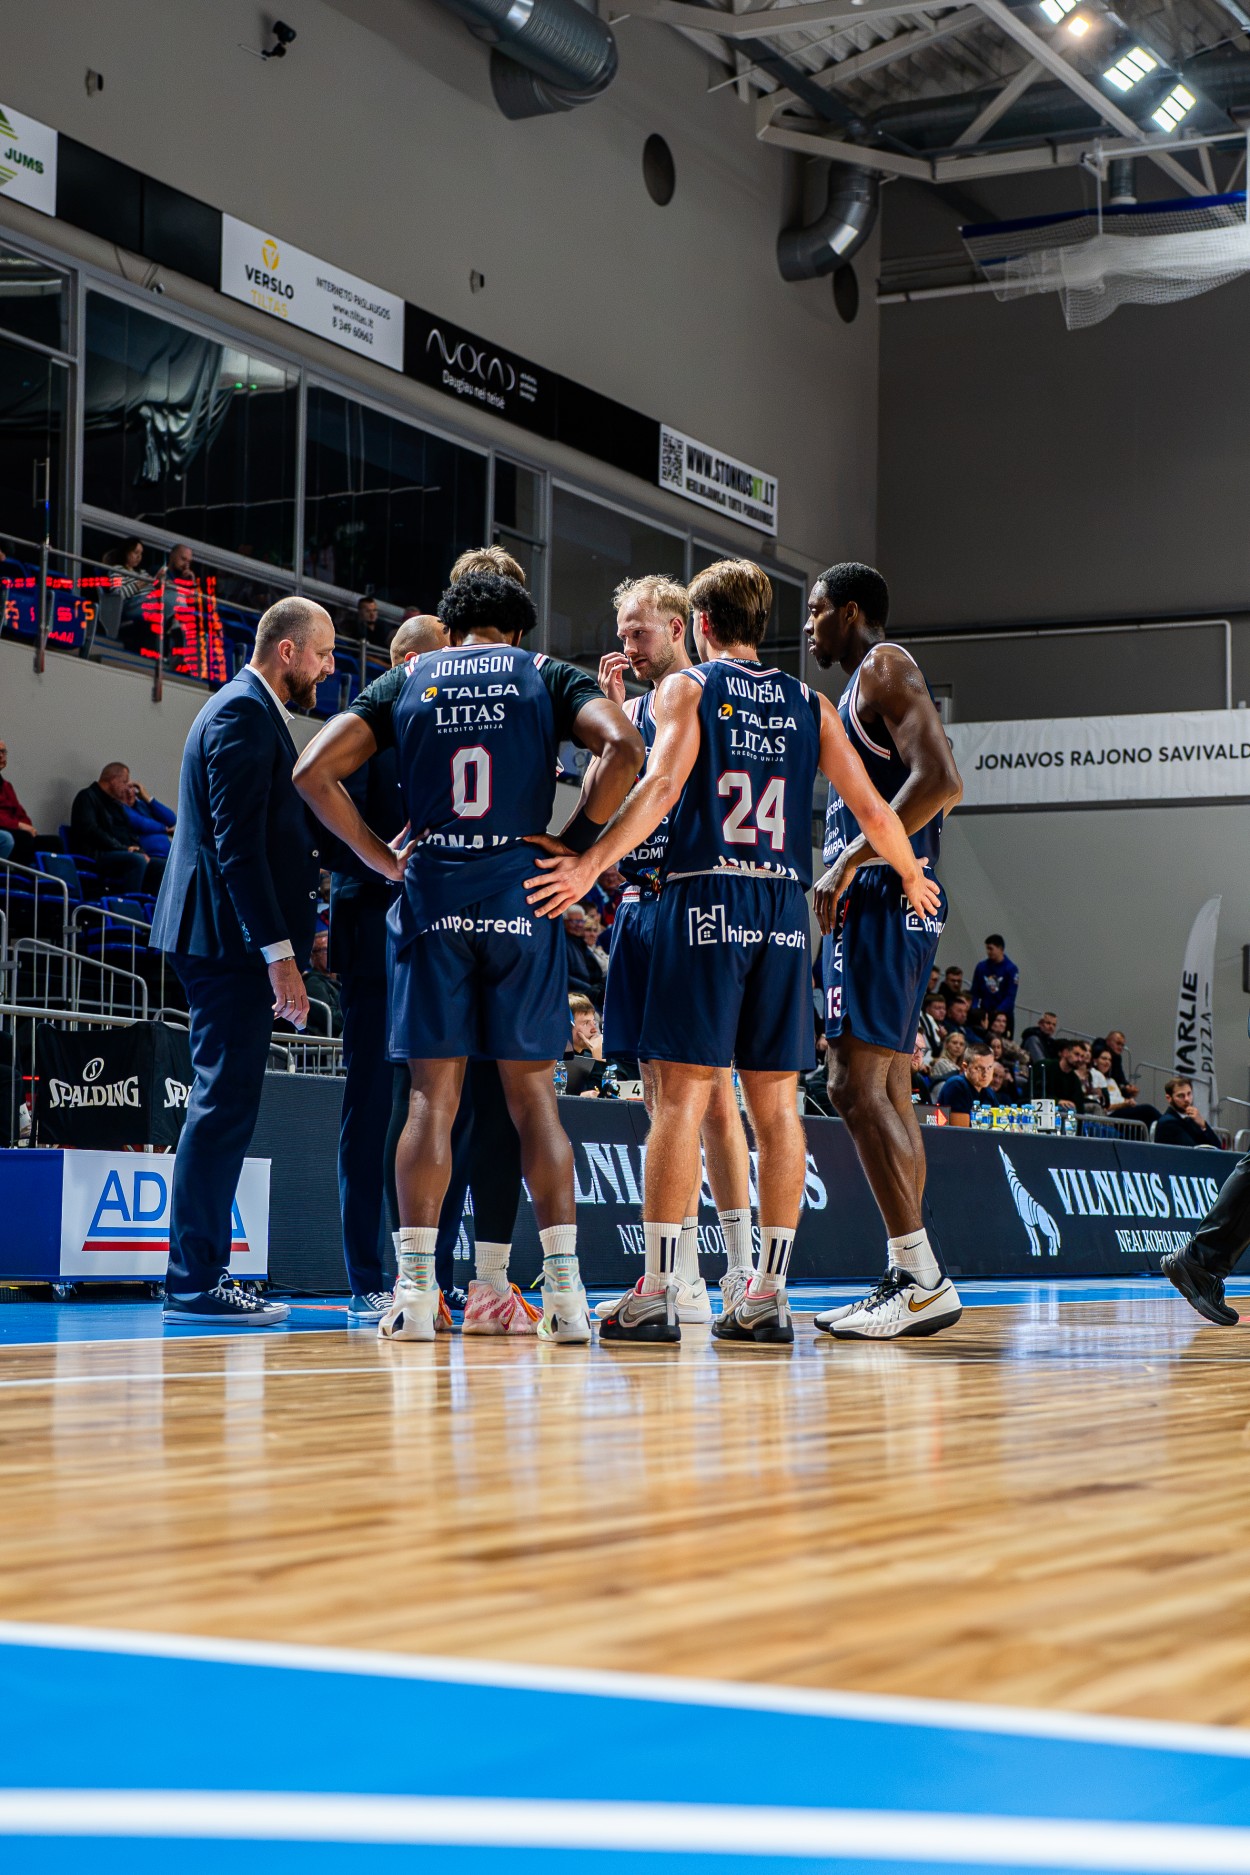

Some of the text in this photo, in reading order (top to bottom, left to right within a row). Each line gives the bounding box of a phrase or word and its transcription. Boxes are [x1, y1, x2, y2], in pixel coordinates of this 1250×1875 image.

[4, 147, 44, 175] JUMS
[245, 264, 294, 300] VERSLO
[251, 289, 288, 318] TILTAS
[430, 655, 514, 679] JOHNSON
[442, 684, 519, 700] TALGA
[435, 703, 505, 726] LITAS
[737, 709, 798, 731] TALGA
[437, 723, 503, 734] KREDITO UNIJA
[730, 728, 786, 754] LITAS
[975, 742, 1250, 770] JONAVOS RAJONO SAVIVALD
[450, 745, 493, 819] 0
[717, 770, 786, 852] 24
[727, 925, 805, 950] hiporedit
[1201, 1012, 1214, 1074] PIZZA
[49, 1075, 139, 1108] SPALDING
[631, 1083, 641, 1096] 4
[1036, 1102, 1043, 1112] 2
[1048, 1168, 1170, 1218] VILNIAUS
